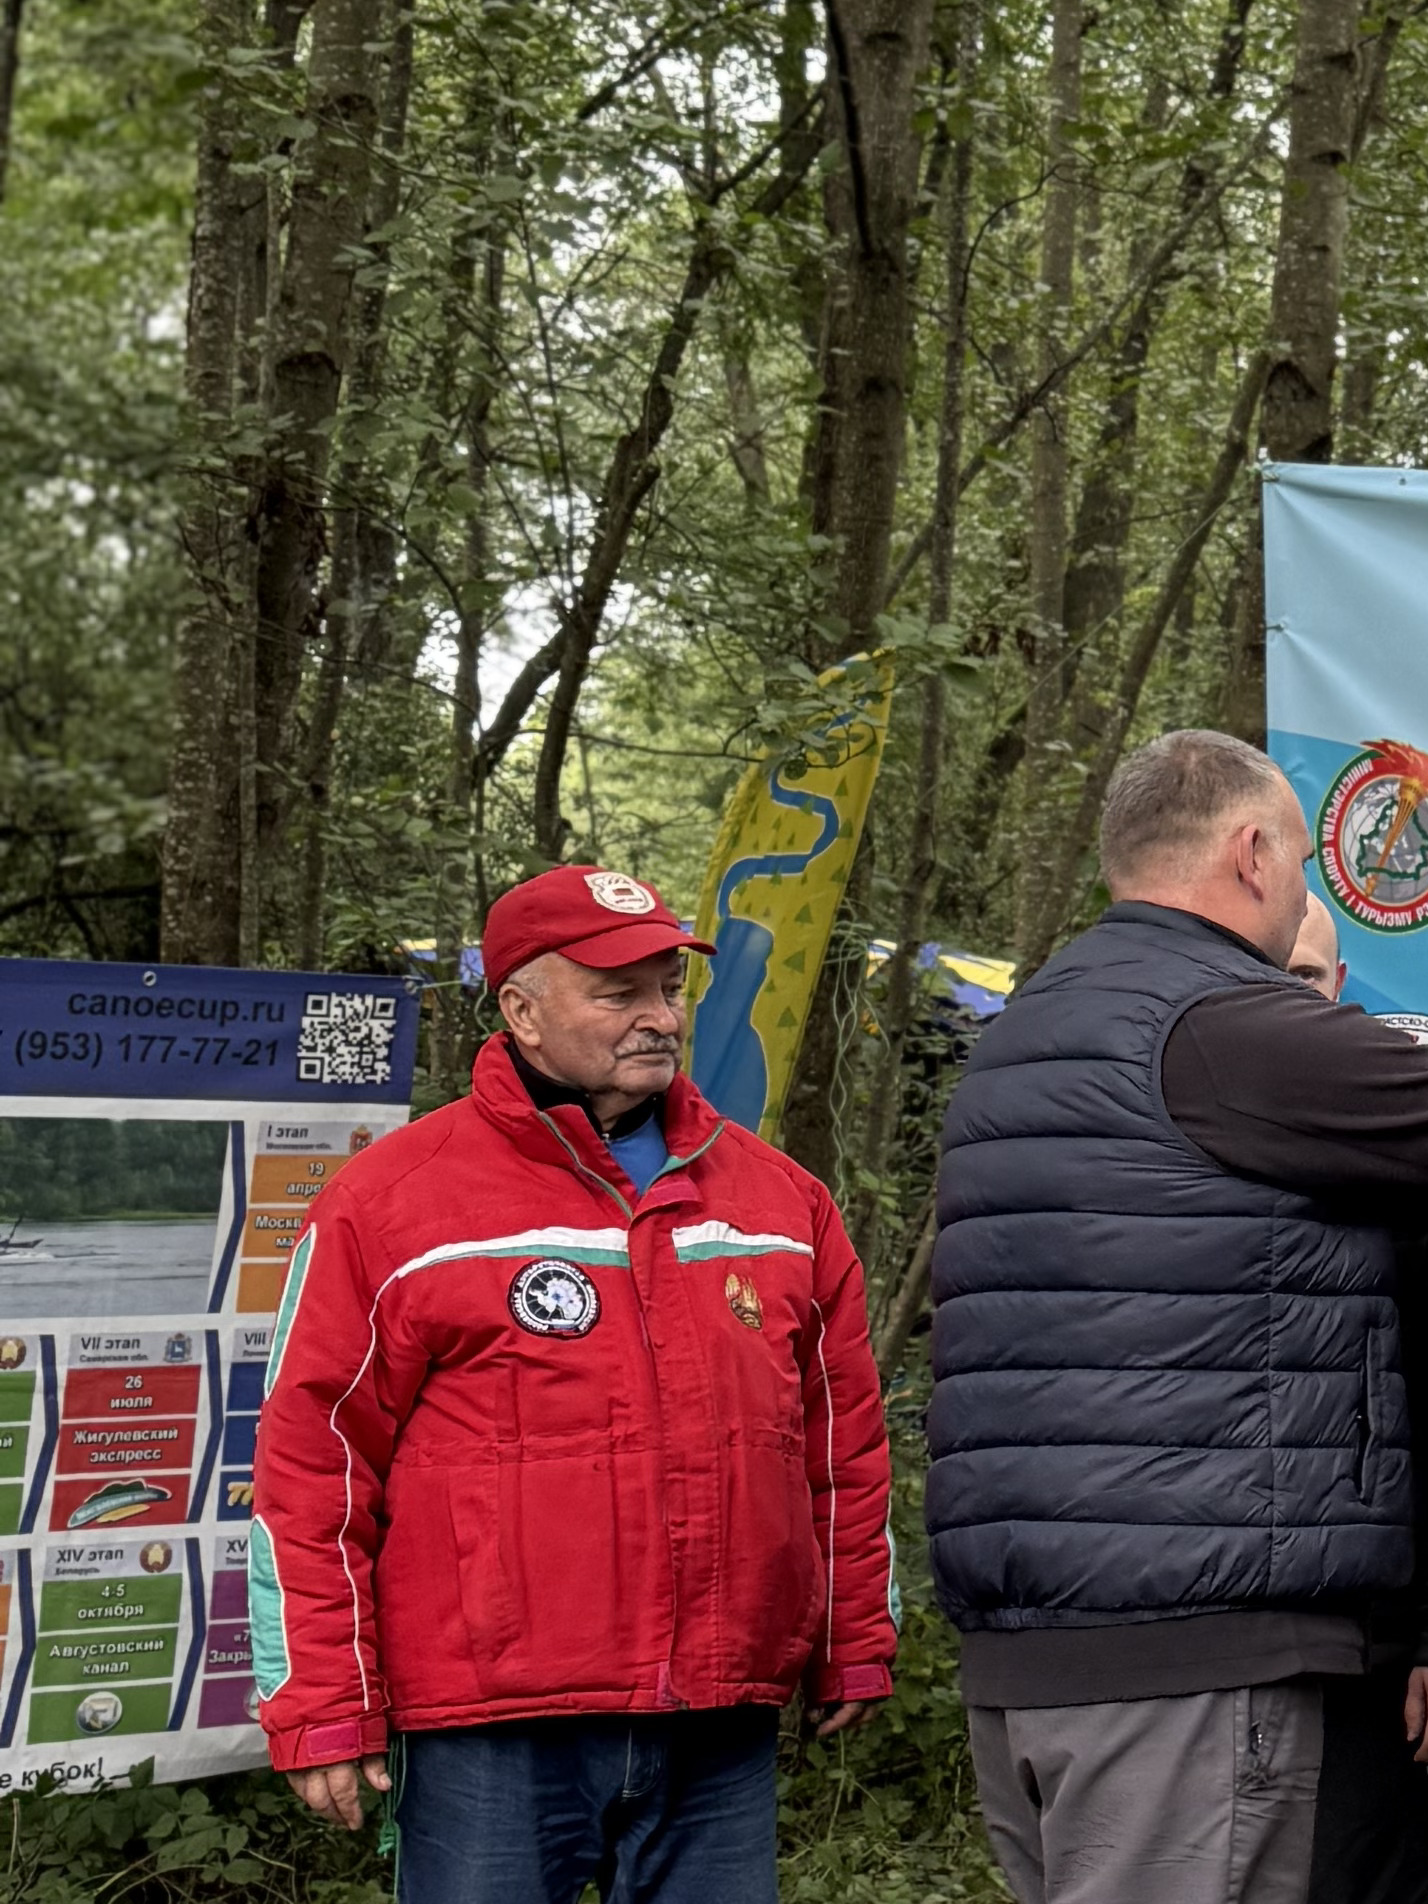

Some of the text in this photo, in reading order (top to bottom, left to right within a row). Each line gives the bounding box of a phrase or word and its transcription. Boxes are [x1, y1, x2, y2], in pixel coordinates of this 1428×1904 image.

[67, 991, 286, 1027] canoecup.ru
[15, 1030, 279, 1068] (953) 177-77-21
[275, 1126, 309, 1139] этап
[308, 1162, 326, 1177] 19
[104, 1338, 142, 1351] этап
[124, 1375, 143, 1389] 26
[109, 1396, 153, 1410] июля
[73, 1427, 179, 1446] Жигулевский
[89, 1448, 163, 1465] экспресс
[56, 1548, 124, 1564] XIV этап
[77, 1604, 144, 1620] октября
[49, 1639, 165, 1659] Августовский
[82, 1661, 130, 1676] канал
[21, 1756, 104, 1788] кбок!
